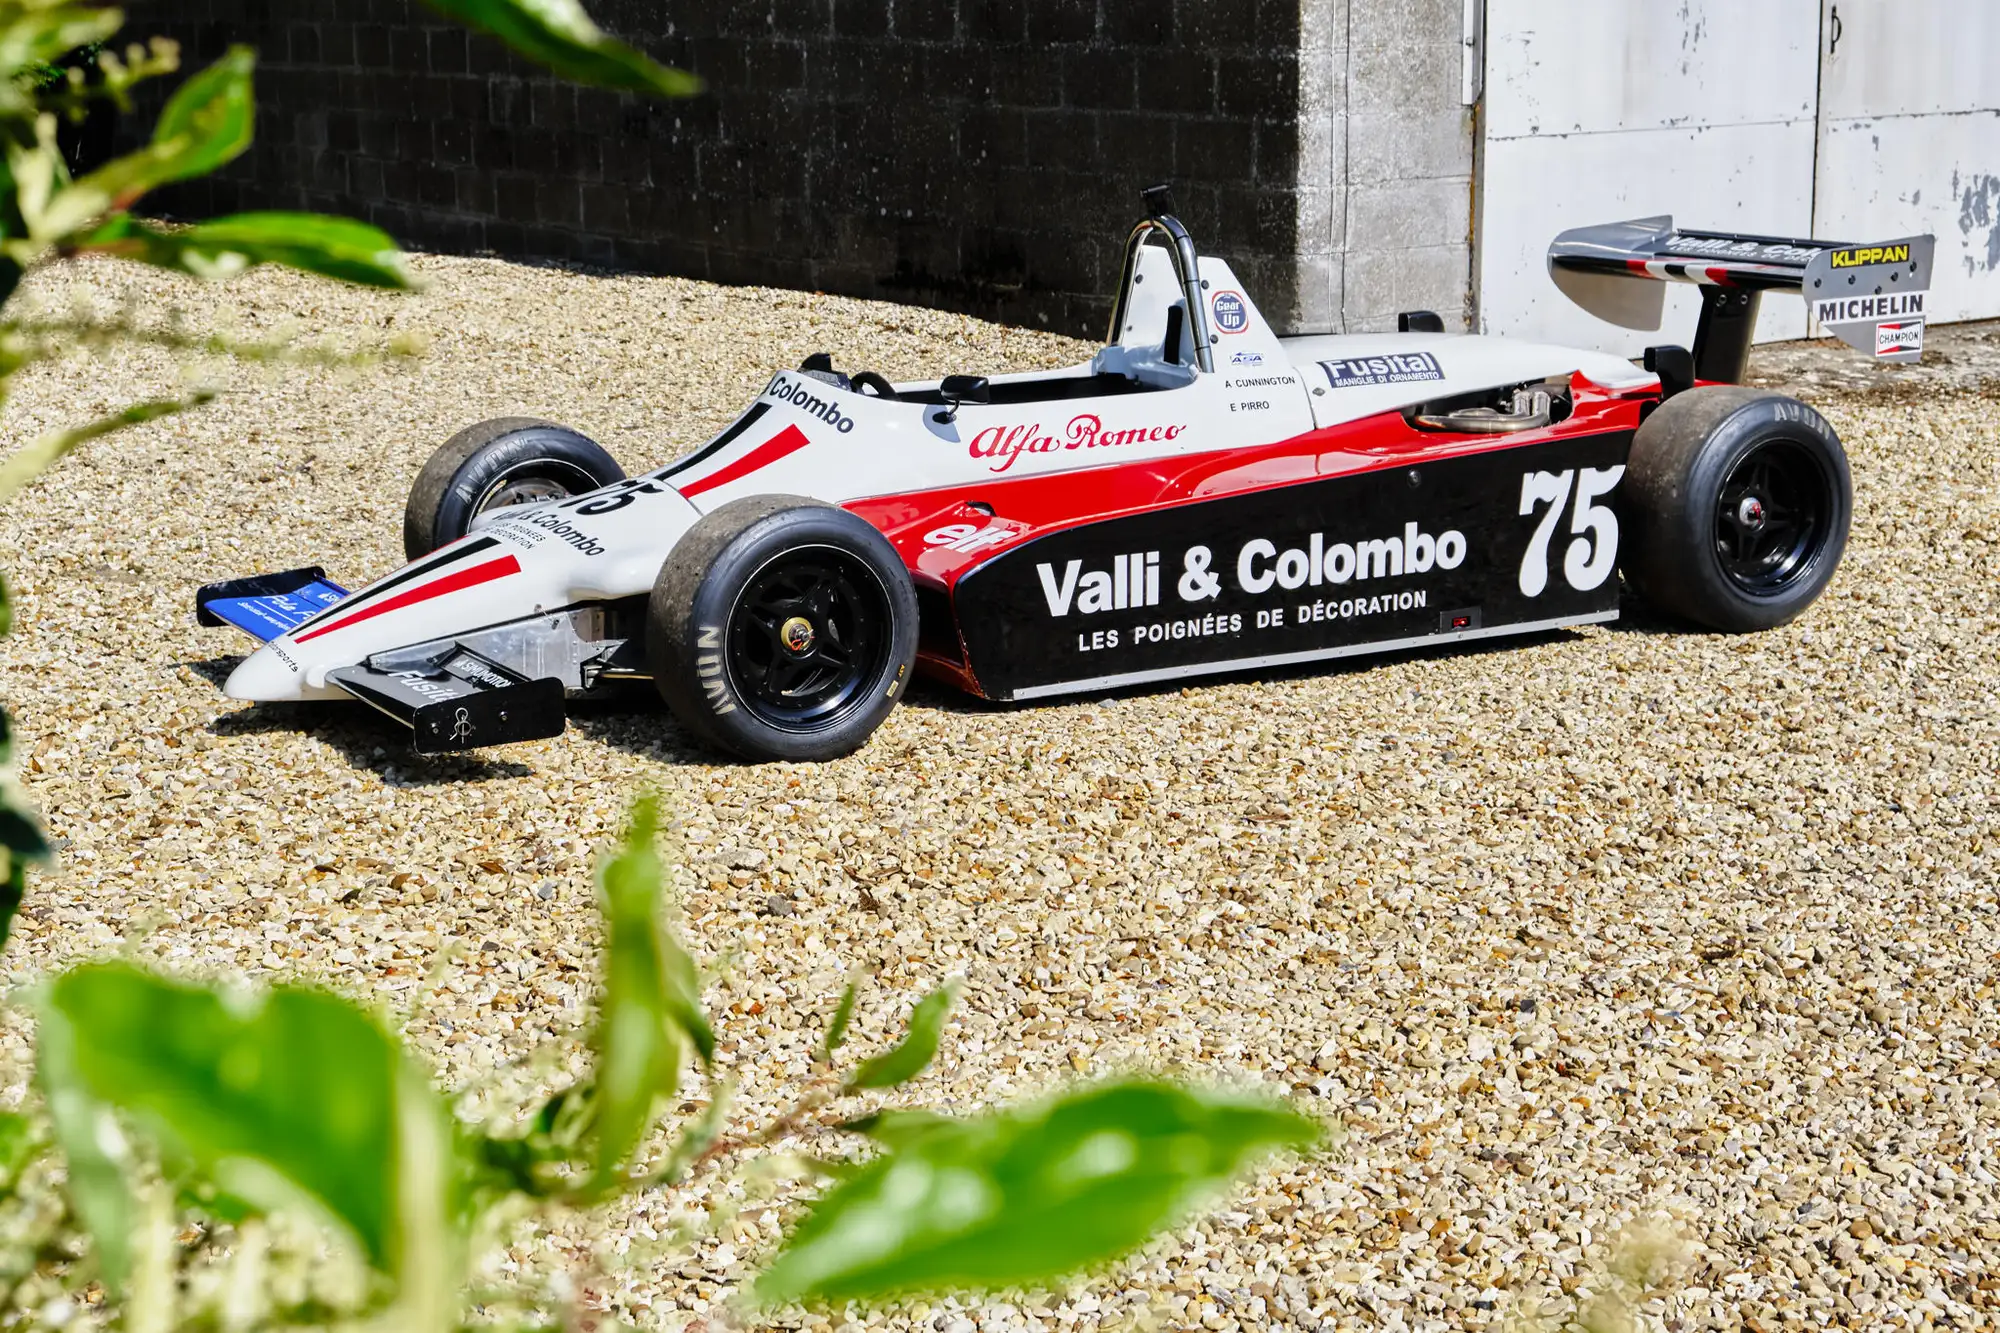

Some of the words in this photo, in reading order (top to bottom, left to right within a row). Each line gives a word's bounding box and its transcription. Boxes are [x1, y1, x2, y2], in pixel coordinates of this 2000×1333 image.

[1831, 244, 1909, 268] KLIPPAN
[1216, 300, 1240, 312] Gear
[1223, 313, 1240, 328] Up
[1820, 294, 1923, 322] MICHELIN
[1879, 331, 1919, 345] CHAMPION
[1325, 353, 1437, 379] Fusital
[1335, 374, 1376, 388] MANIGLIE
[1377, 374, 1388, 384] DI
[1389, 371, 1440, 383] ORNAMENTO
[1225, 380, 1232, 389] A
[1235, 376, 1296, 388] CUNNINGTON
[769, 376, 855, 434] Colombo
[1230, 403, 1237, 412] E
[1241, 400, 1270, 411] PIRRO
[1773, 402, 1831, 440] AVON
[969, 423, 1060, 472] Alfa
[1064, 413, 1188, 450] Romeo
[455, 436, 529, 506] AVON
[531, 510, 606, 556] Colombo
[923, 524, 1018, 553] elf
[1518, 464, 1627, 598] 75
[1036, 551, 1160, 618] Valli
[1178, 545, 1222, 602] &
[1237, 521, 1467, 594] Colombo
[1078, 629, 1119, 651] LES
[1134, 612, 1242, 645] POIGNÉES
[1256, 608, 1284, 629] DE
[1298, 590, 1427, 624] DÉCORATION
[387, 669, 466, 703] Fusit
[696, 626, 738, 715] AVON
